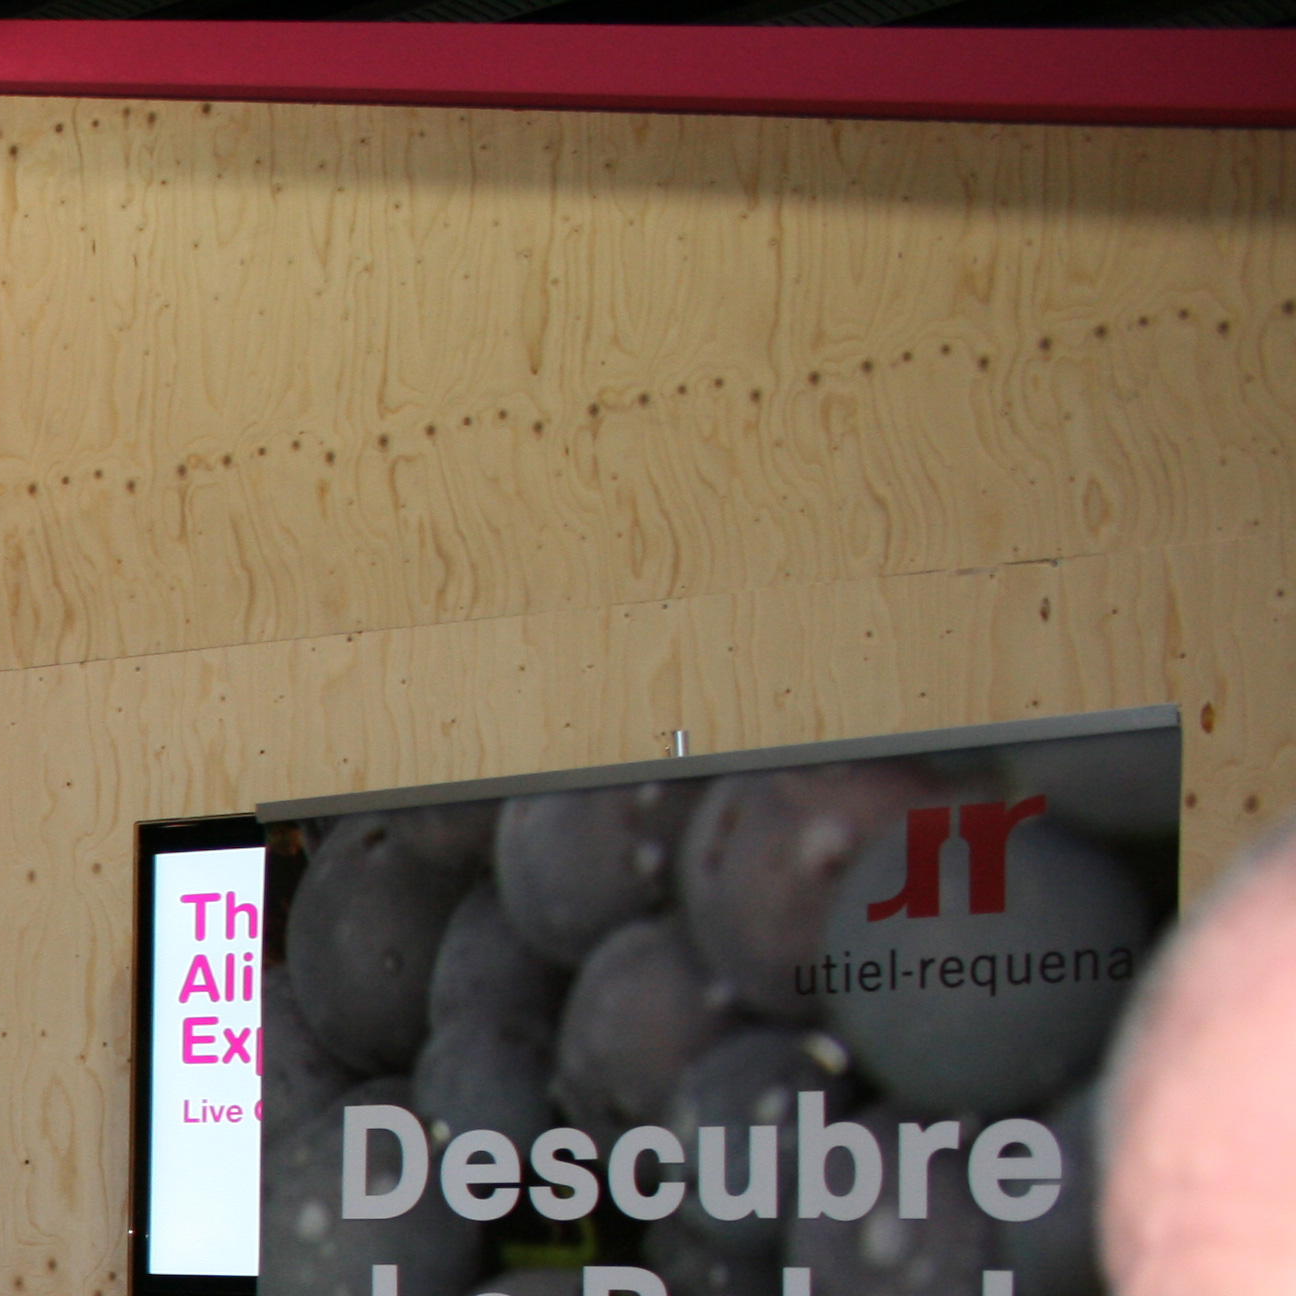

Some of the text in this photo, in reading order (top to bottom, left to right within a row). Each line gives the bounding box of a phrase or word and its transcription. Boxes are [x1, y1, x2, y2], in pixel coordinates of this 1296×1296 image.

[179, 891, 259, 941] Th
[178, 952, 254, 1004] Ali
[794, 947, 1134, 997] utiel-requena
[182, 1016, 263, 1076] Ex
[183, 1098, 244, 1123] Live
[341, 1090, 1063, 1222] Descubre
